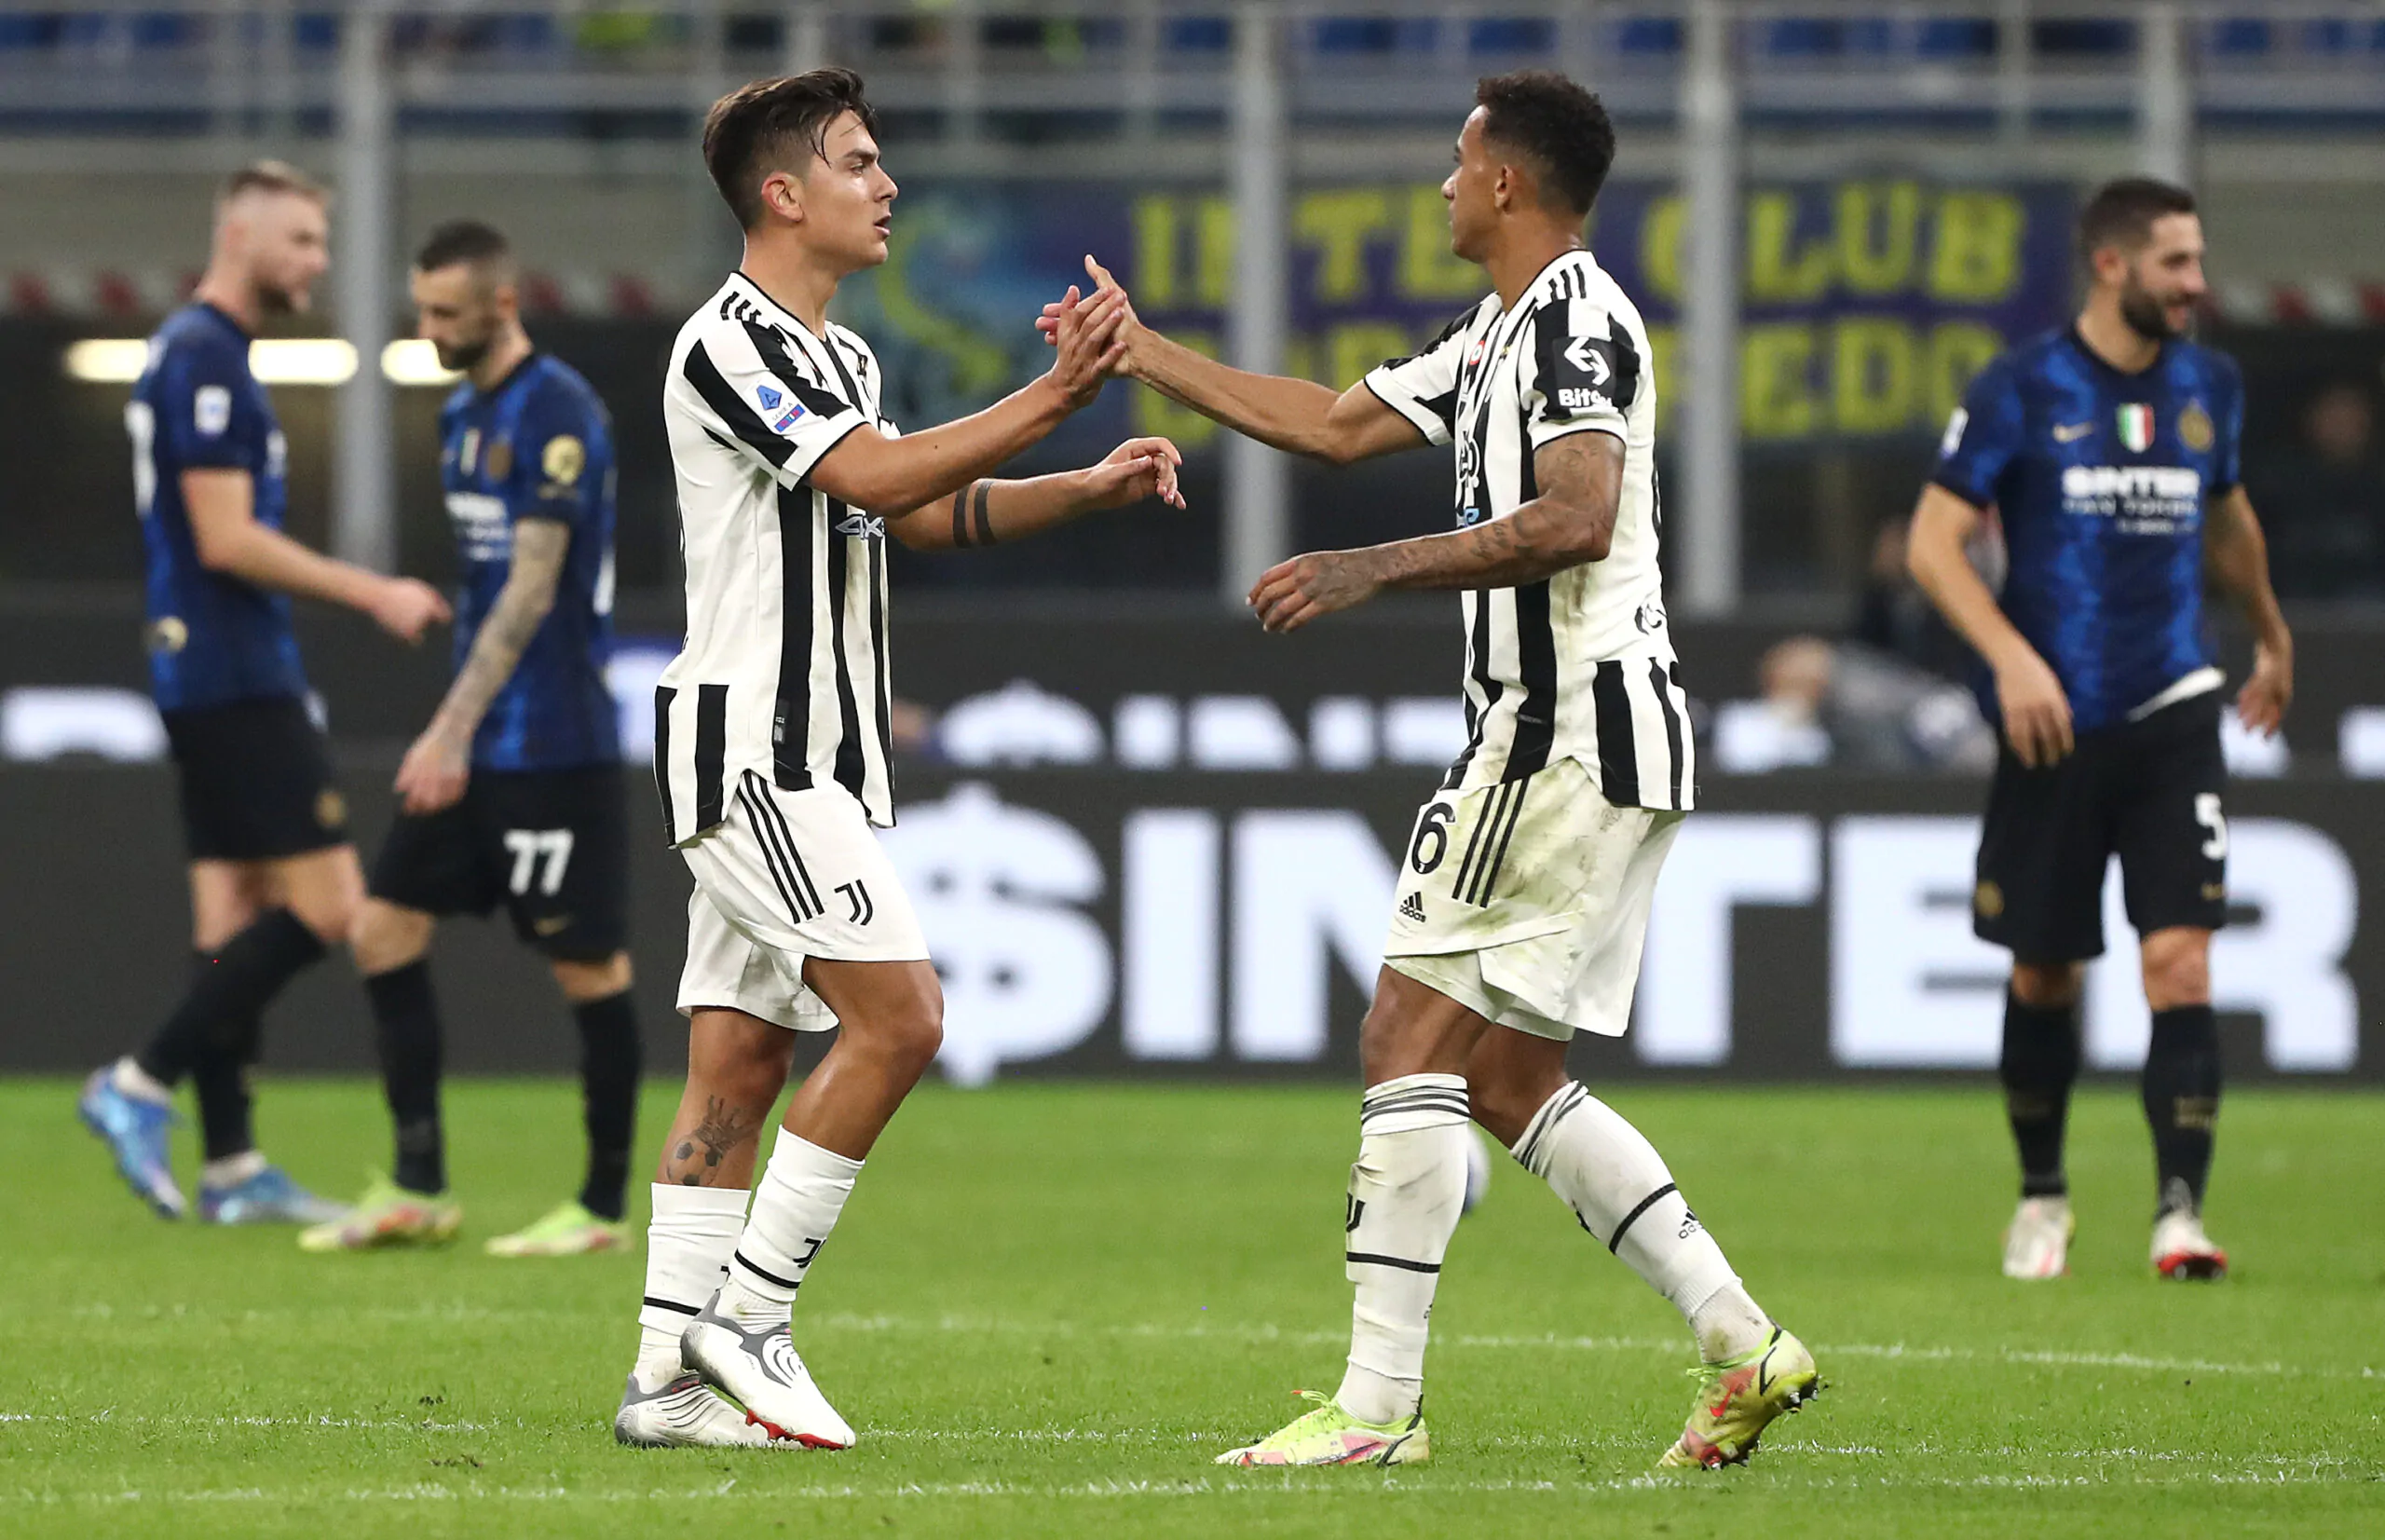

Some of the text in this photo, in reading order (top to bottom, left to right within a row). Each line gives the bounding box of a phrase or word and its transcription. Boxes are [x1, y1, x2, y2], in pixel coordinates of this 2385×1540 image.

[1411, 802, 1455, 875] 6
[2194, 792, 2227, 860] 5
[504, 828, 575, 895] 77
